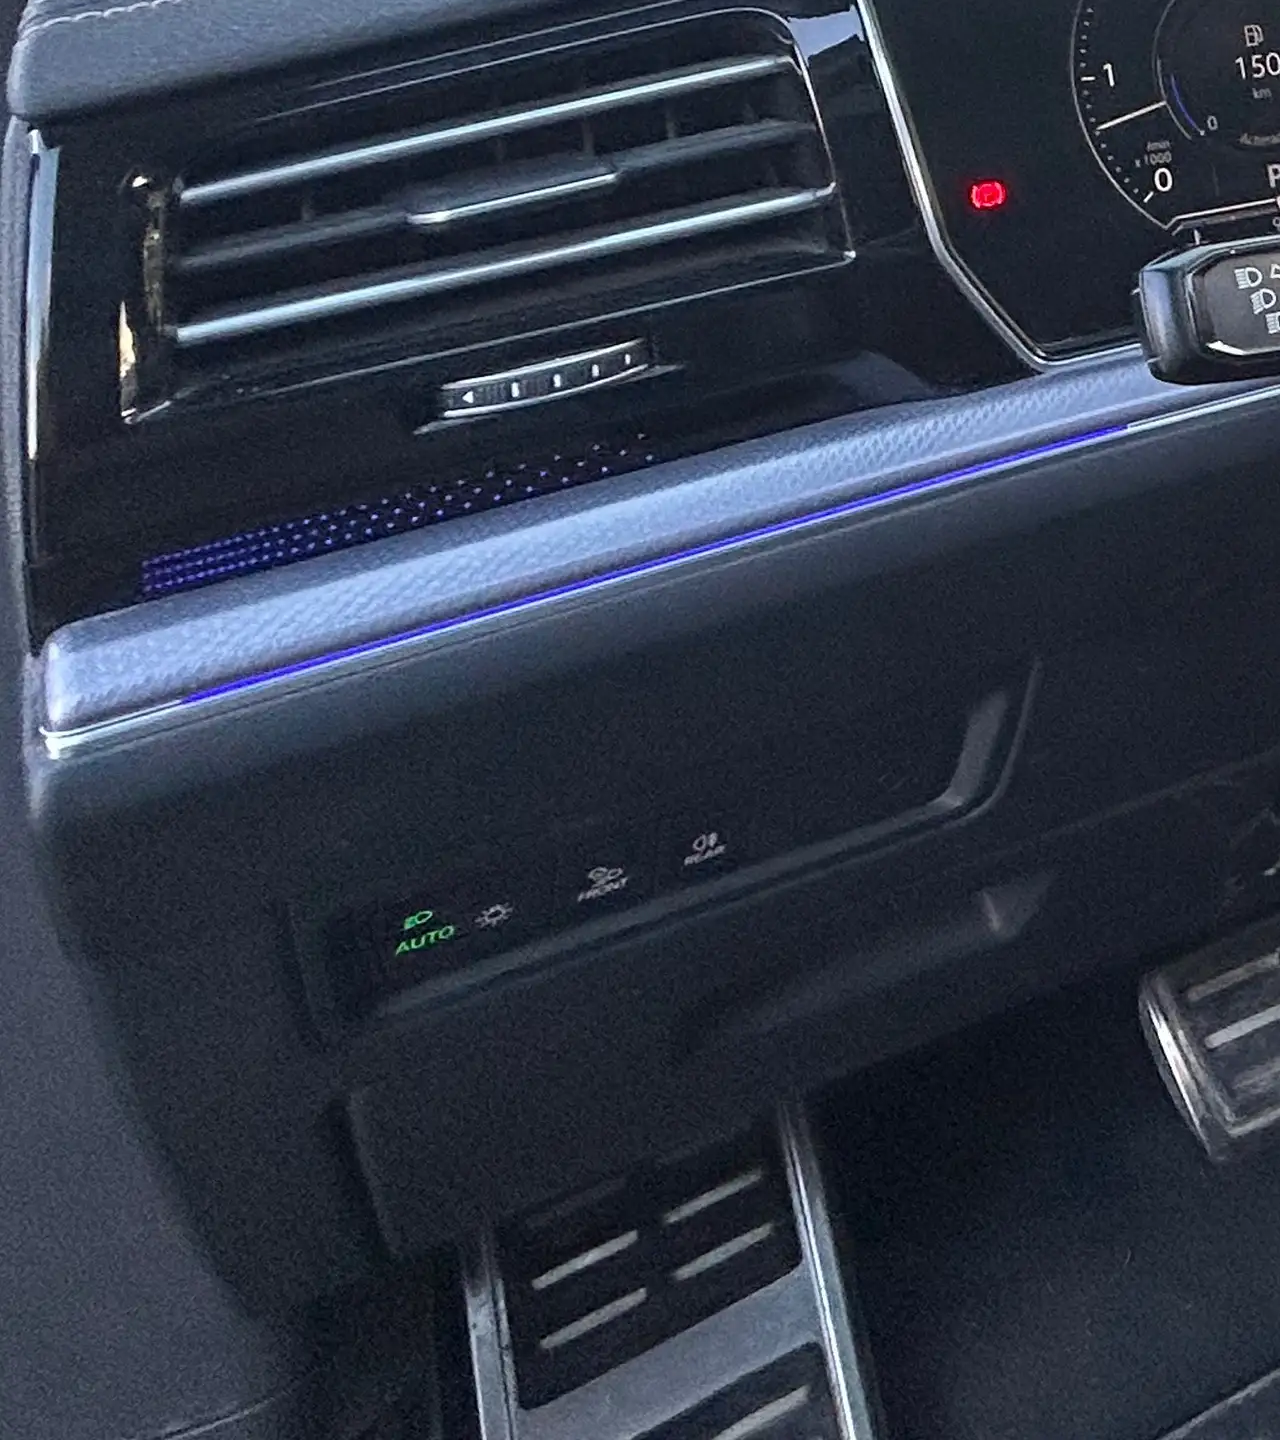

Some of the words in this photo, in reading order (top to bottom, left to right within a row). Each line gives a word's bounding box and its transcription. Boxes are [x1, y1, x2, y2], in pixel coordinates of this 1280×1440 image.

[1102, 62, 1116, 87] 1
[1252, 88, 1272, 99] km
[1207, 115, 1218, 131] 0
[1154, 167, 1174, 192] 0
[395, 925, 455, 956] AUTO
